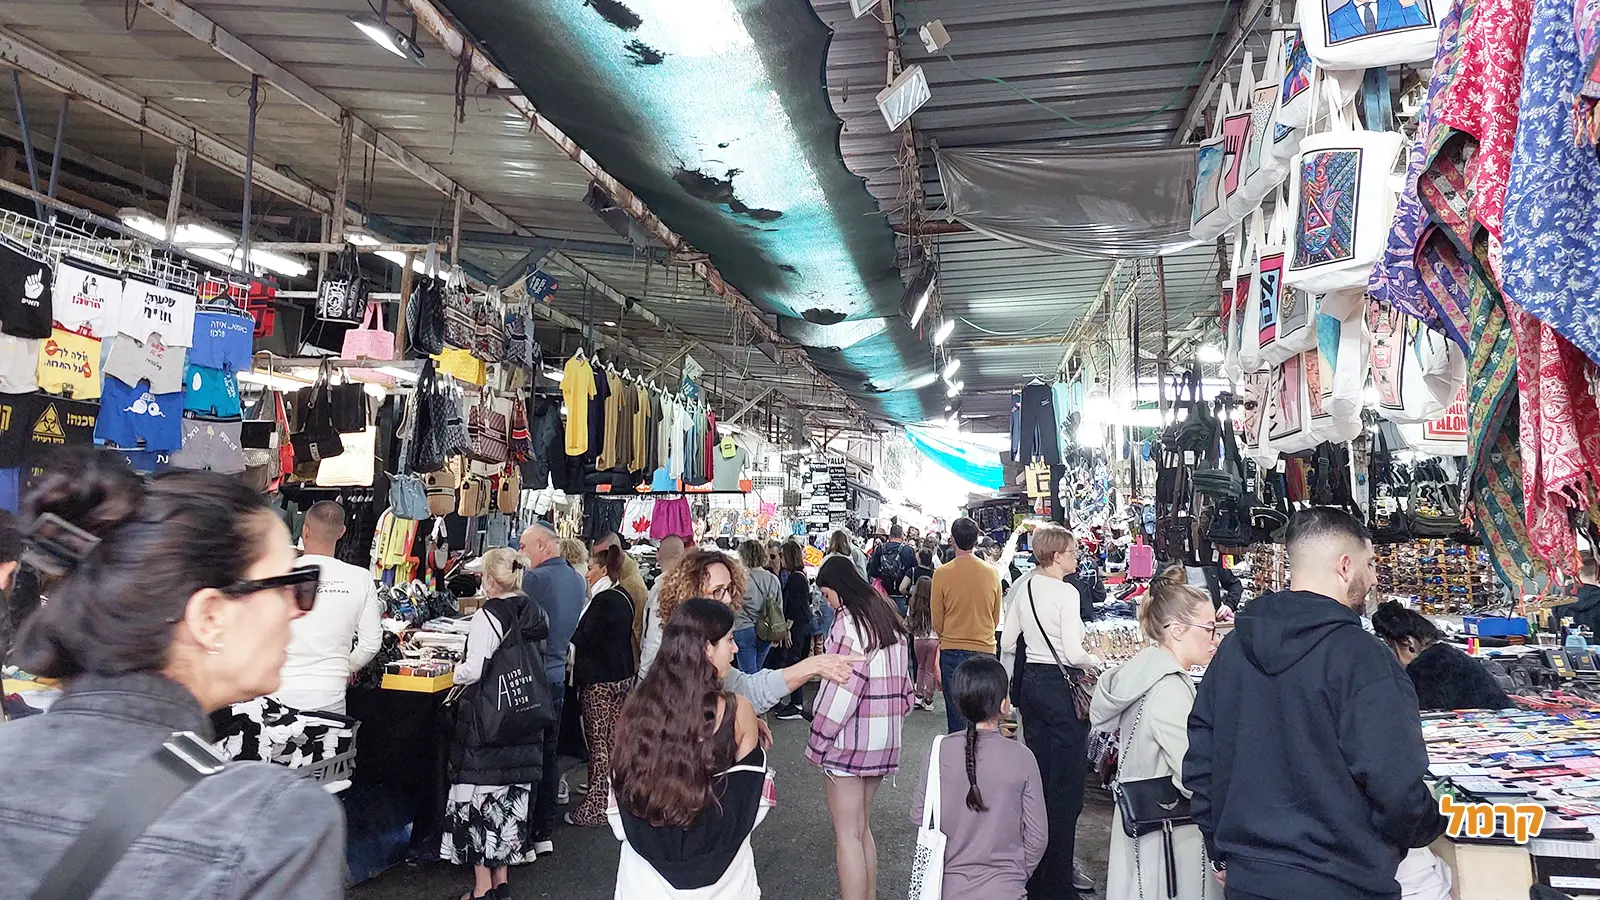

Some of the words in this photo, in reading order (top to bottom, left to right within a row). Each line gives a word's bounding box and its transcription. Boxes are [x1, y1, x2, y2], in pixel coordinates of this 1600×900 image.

[1244, 374, 1262, 385] GUE
[66, 412, 95, 428] סכנה!
[1436, 416, 1467, 431] ALON
[827, 457, 845, 465] YALLA
[509, 675, 533, 688] ארטיסט
[514, 696, 529, 706] אביב
